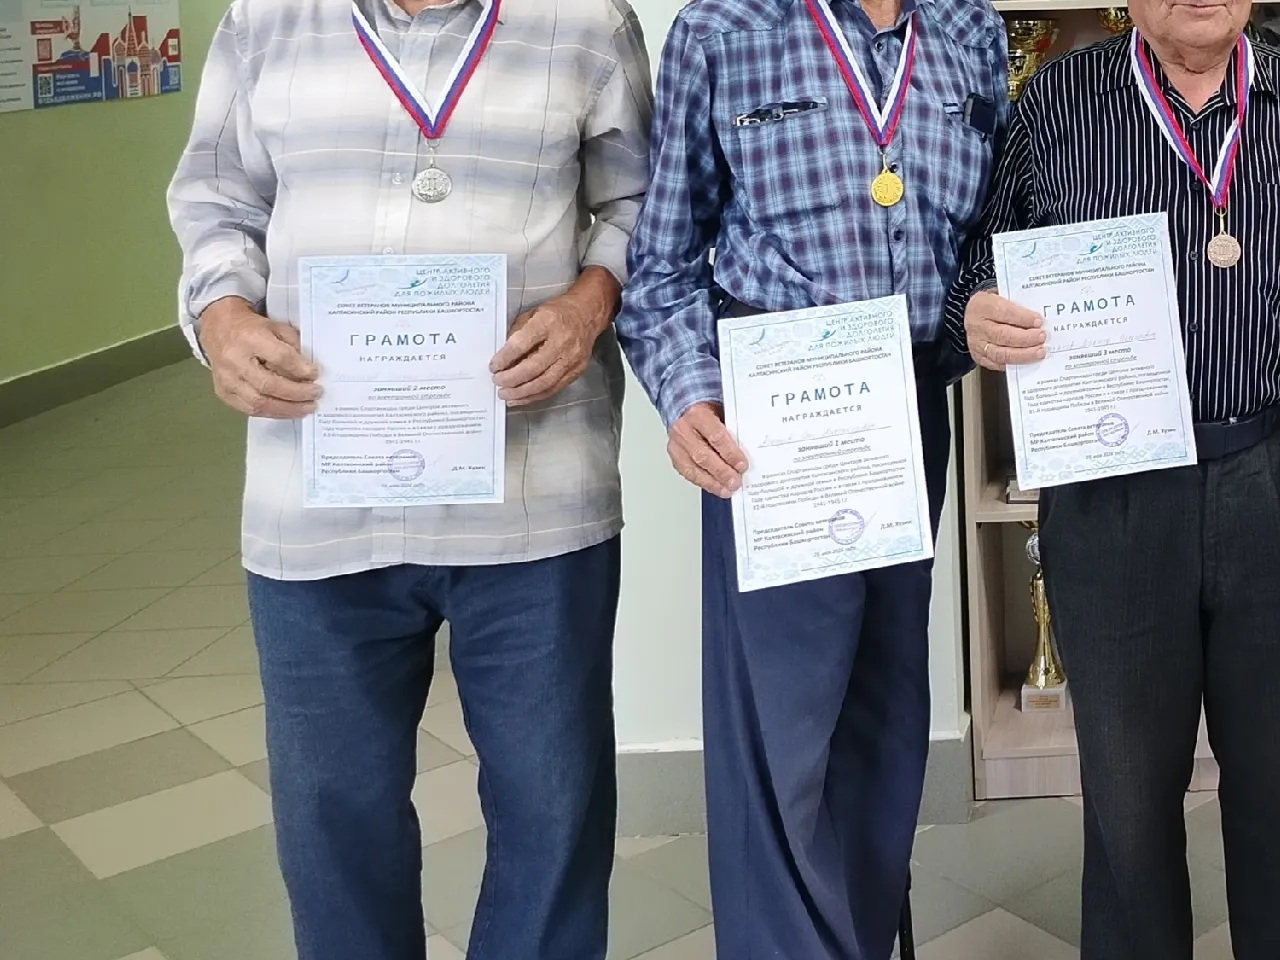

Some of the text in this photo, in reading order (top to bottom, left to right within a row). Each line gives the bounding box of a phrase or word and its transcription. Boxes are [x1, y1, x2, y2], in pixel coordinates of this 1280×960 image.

[1043, 294, 1135, 317] ГРАМОТА
[1053, 316, 1128, 332] НАГРАЖДАЕТСЯ
[350, 332, 456, 346] ГРАМОТА
[359, 354, 446, 362] НАГРАЖДАЕТСЯ
[770, 380, 870, 407] ГРАМОТА
[782, 404, 861, 423] НАГРАЖДАЕТСЯ
